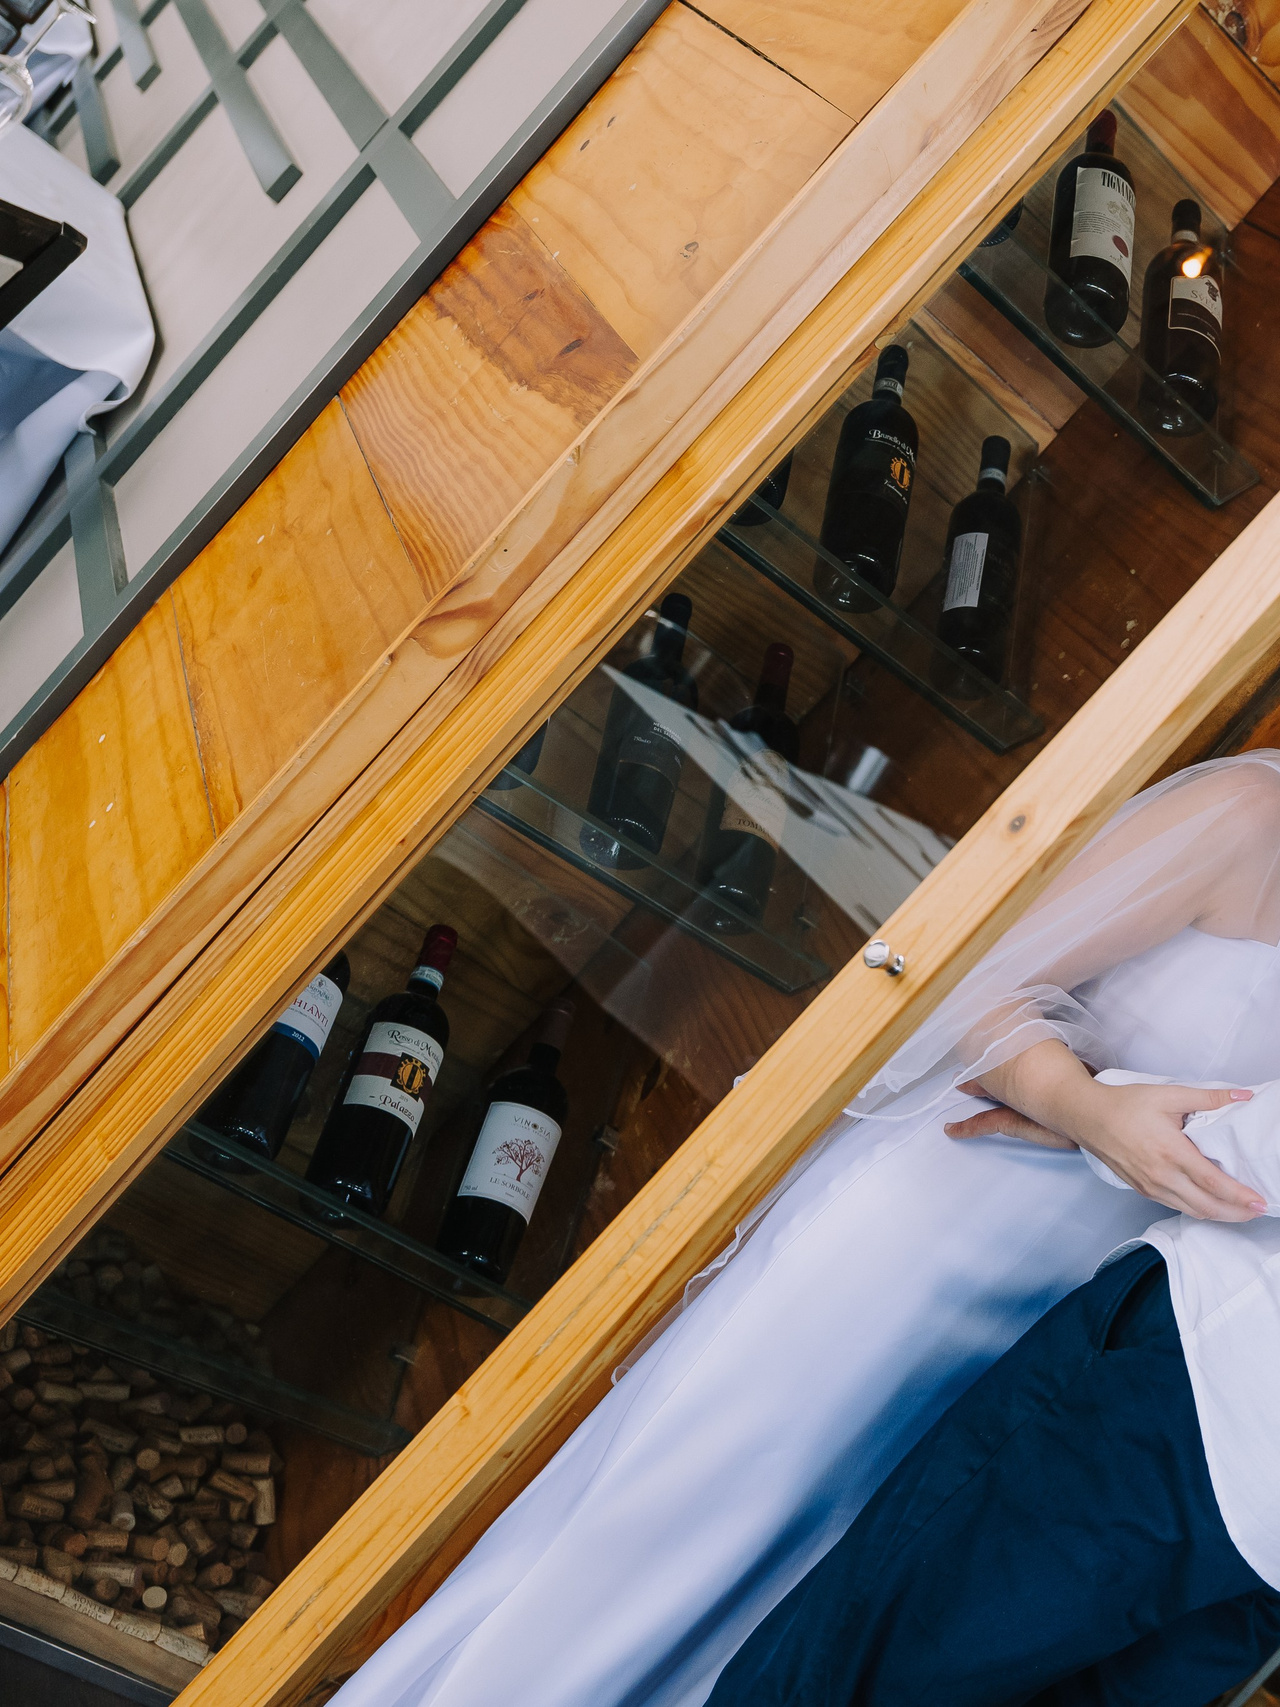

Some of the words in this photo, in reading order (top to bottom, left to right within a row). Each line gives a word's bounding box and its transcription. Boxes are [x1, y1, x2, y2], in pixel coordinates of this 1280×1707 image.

[293, 998, 329, 1027] HIANTI
[387, 1029, 414, 1045] Rosso
[379, 1094, 415, 1122] Palazzo
